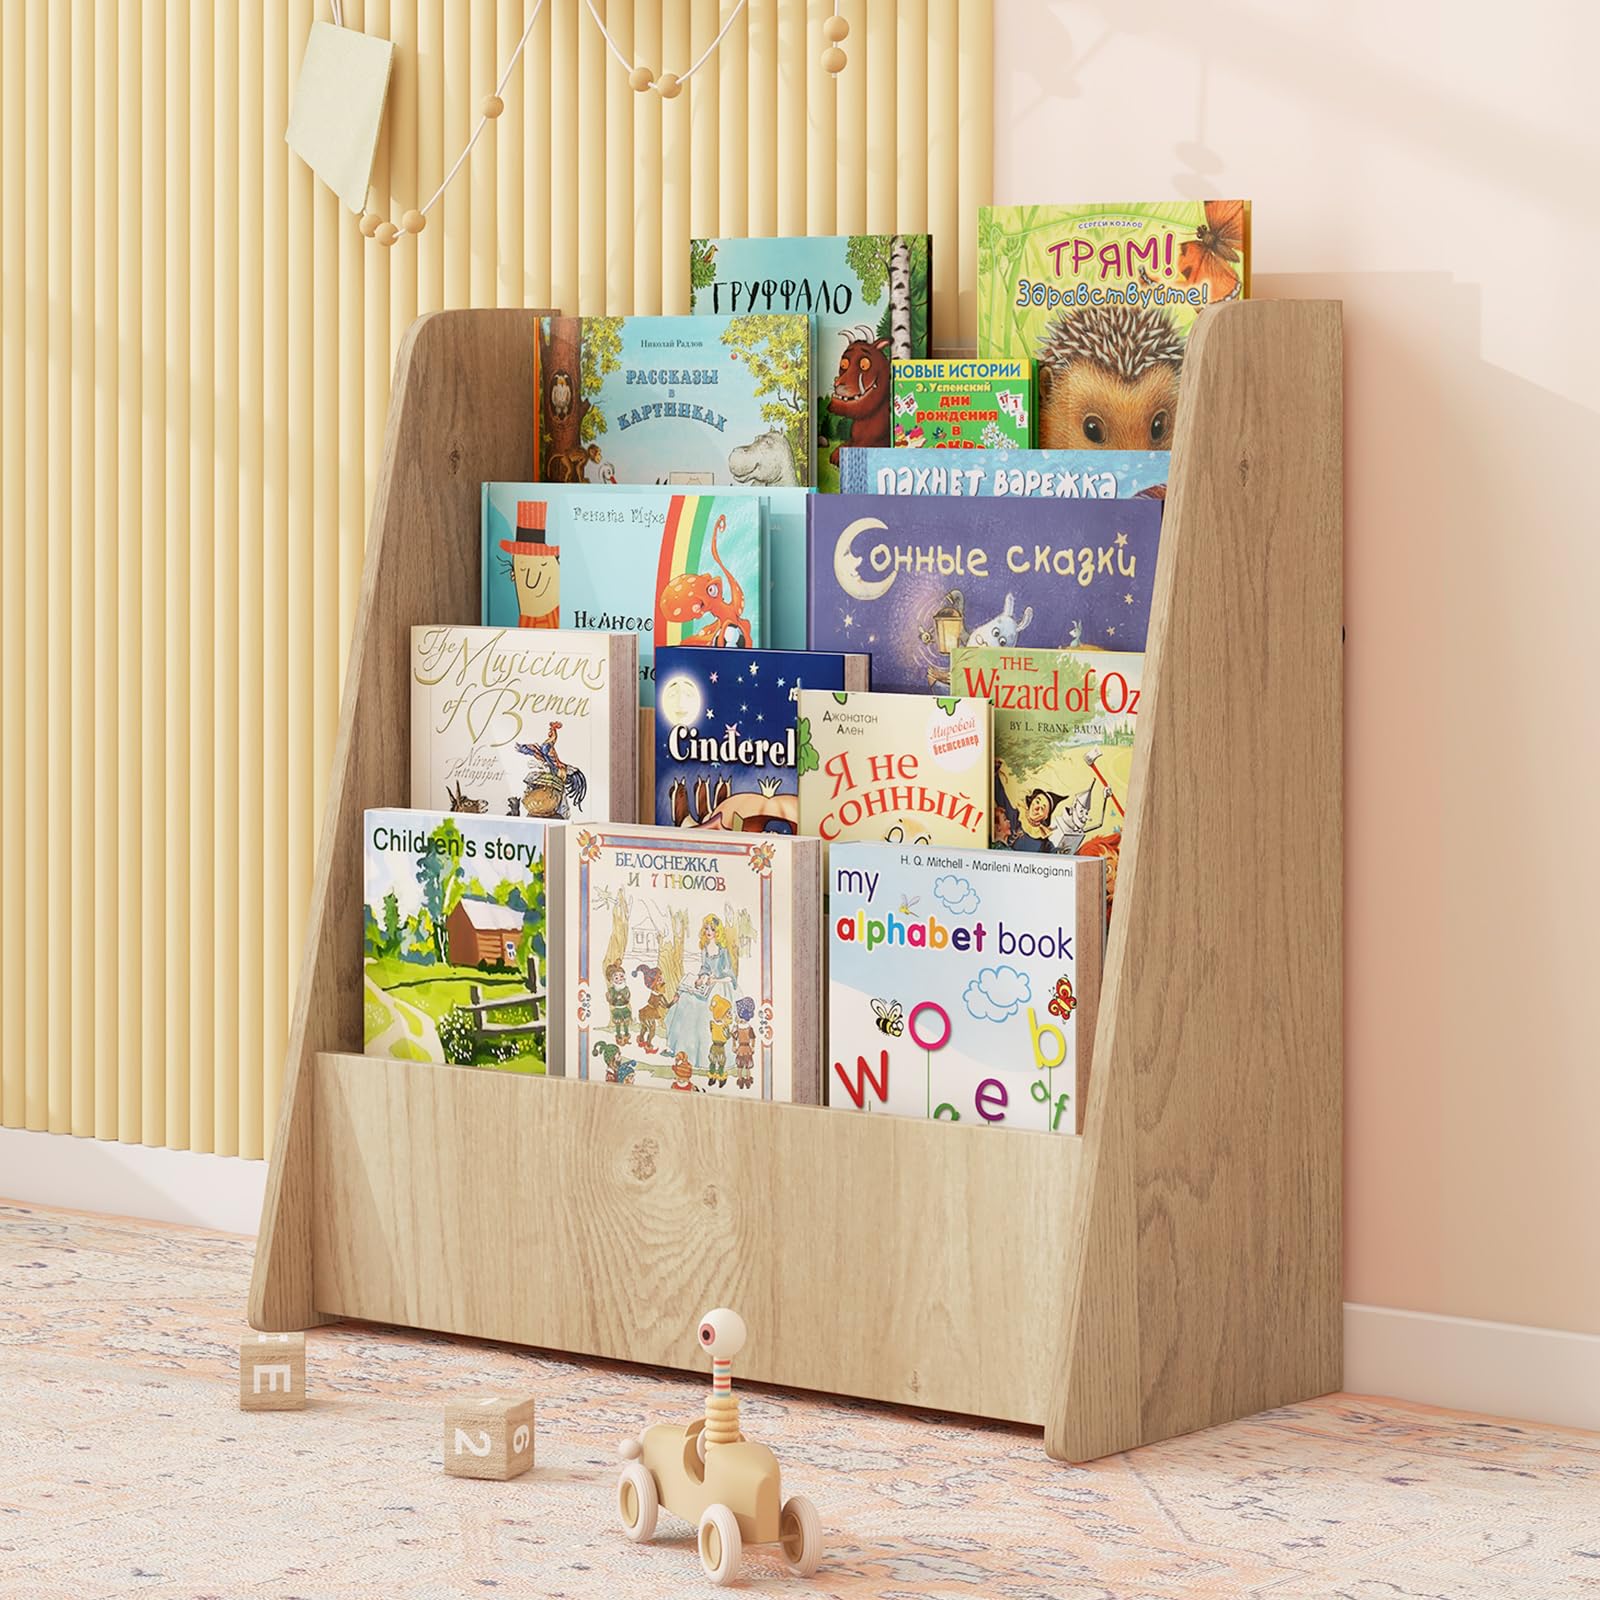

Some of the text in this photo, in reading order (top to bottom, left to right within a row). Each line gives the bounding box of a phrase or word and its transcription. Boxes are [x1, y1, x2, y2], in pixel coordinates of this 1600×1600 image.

[1110, 221, 1143, 229] КОЗЛОВ
[1048, 233, 1173, 278] ТРЯМ!
[713, 278, 852, 315] ГРУФФАЛО
[1016, 280, 1208, 310] Здравствуйте!
[640, 339, 703, 348] Николай Радлов
[626, 369, 719, 385] РАССКАЗЫ
[893, 363, 1020, 378] НОВЫЕ ИСТОРИИ
[916, 381, 992, 393] Э. Успенский
[617, 402, 728, 432] КАРТИНКАХ
[916, 410, 998, 423] рождения
[573, 506, 665, 527] Рената Муха
[1007, 544, 1136, 587] сказки
[414, 628, 606, 690] Musicians
[418, 627, 456, 672] The
[1000, 656, 1039, 672] THE
[963, 667, 1141, 715] Wizard of Oz
[436, 678, 590, 747] of Bremen
[822, 710, 878, 724] Джонатан
[836, 724, 864, 736] Ален
[930, 717, 977, 741] Мировой
[1010, 721, 1101, 735] BY L. FRANK BAUM
[824, 751, 858, 800] Я
[373, 827, 537, 868] Children's story
[616, 852, 719, 873] БЕЛОСНЕЖКА
[900, 855, 911, 865] H.
[913, 856, 924, 866] Q.
[926, 857, 963, 869] Mitchell
[972, 860, 1011, 873] Marileni
[1013, 862, 1073, 878] Malkogianni
[627, 872, 726, 891] И 7 ГНОМОВ
[837, 868, 879, 902] my
[837, 910, 1074, 960] alphabet book
[975, 1078, 1008, 1122] e
[253, 1364, 291, 1393] E
[455, 1427, 492, 1457] 2
